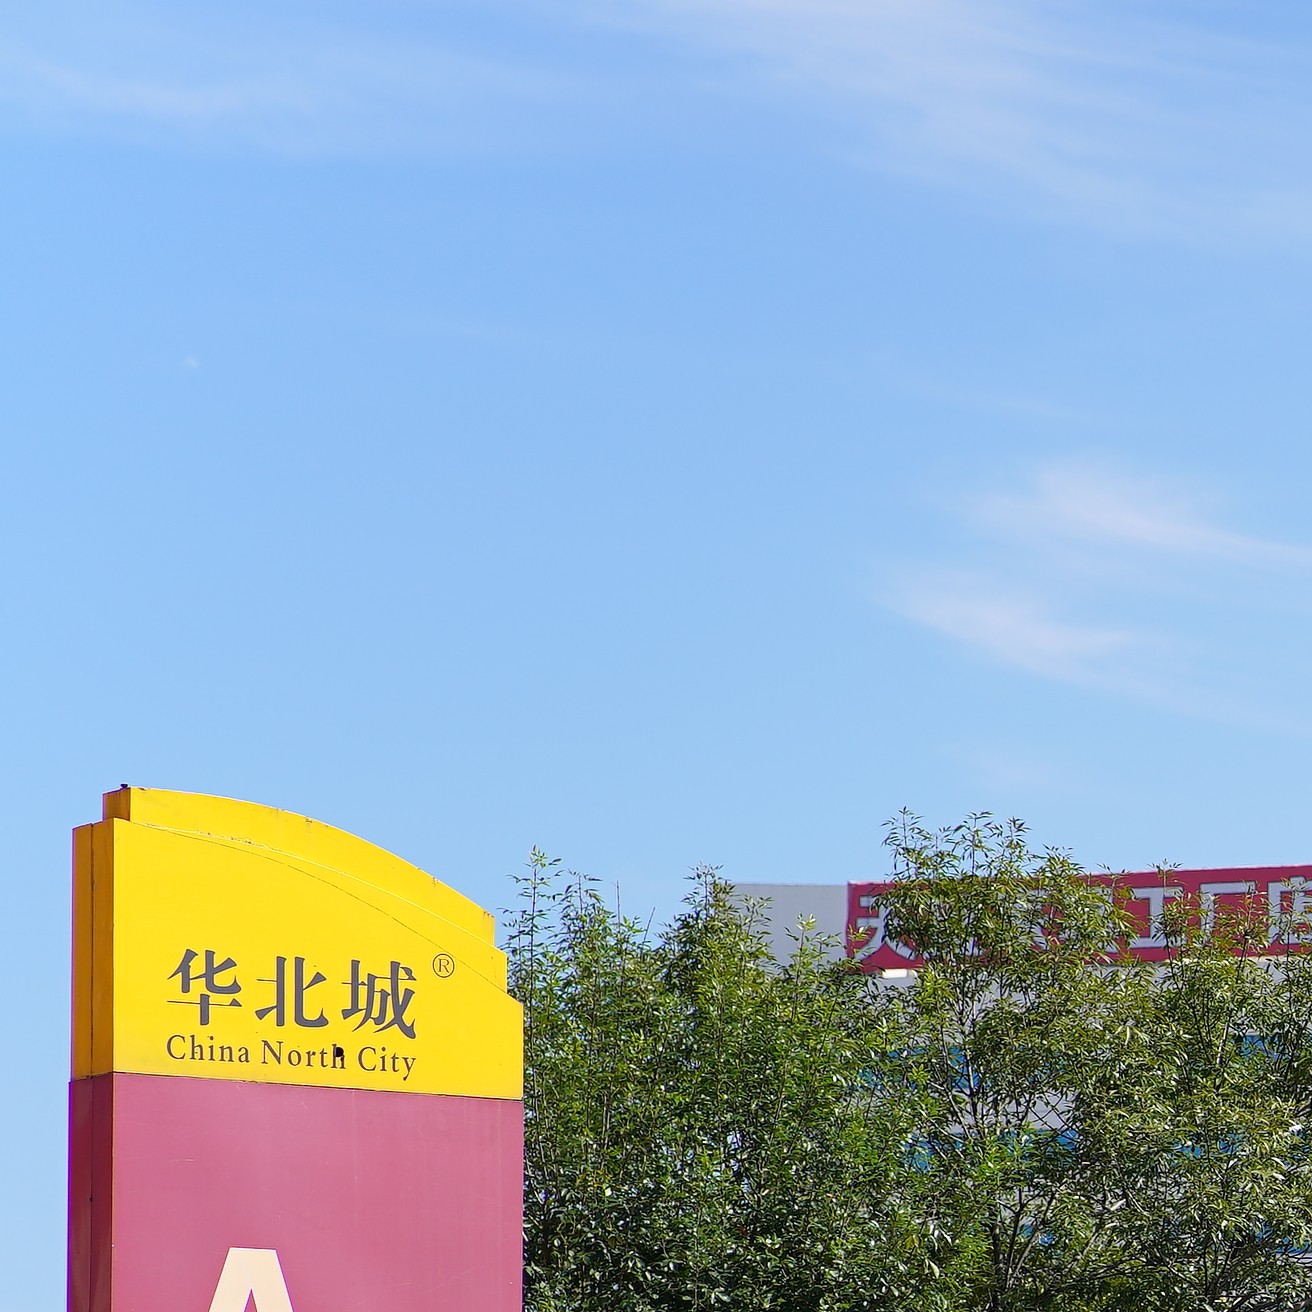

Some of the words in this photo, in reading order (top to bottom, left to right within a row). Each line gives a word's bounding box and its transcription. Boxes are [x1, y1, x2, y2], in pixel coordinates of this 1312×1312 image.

[166, 949, 417, 1040] 华北城
[167, 1034, 250, 1063] China
[261, 1040, 346, 1070] North
[358, 1046, 417, 1081] City
